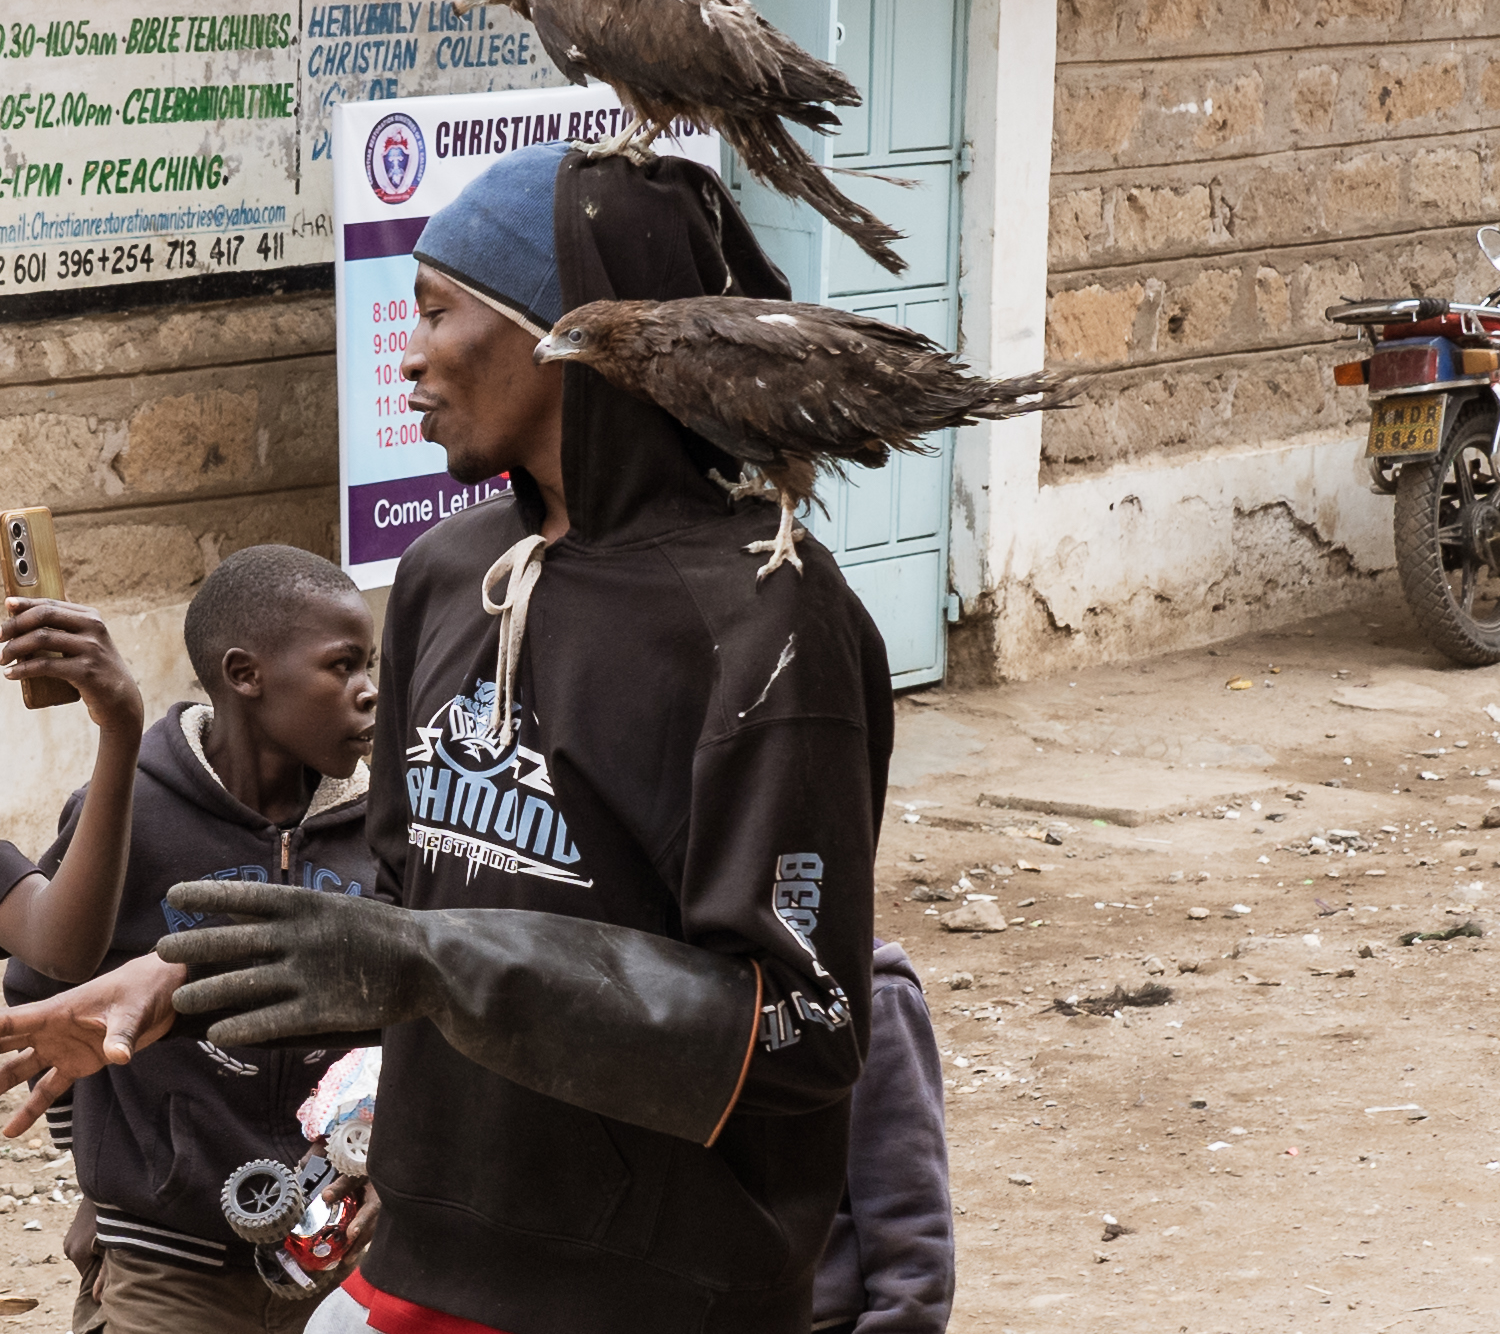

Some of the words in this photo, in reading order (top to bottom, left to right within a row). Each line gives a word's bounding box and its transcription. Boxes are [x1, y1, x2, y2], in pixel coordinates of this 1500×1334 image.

[124, 15, 184, 55] BIBLE
[308, 38, 418, 78] CHRISTIAN
[435, 112, 562, 159] CHRISTIAN
[13, 252, 46, 284] 601
[164, 238, 197, 270] 713
[209, 234, 246, 266] 417
[256, 232, 285, 262] 411
[373, 299, 407, 323] 8:00
[373, 331, 408, 355] 9:00
[373, 494, 434, 529] Come
[438, 487, 470, 521] Let
